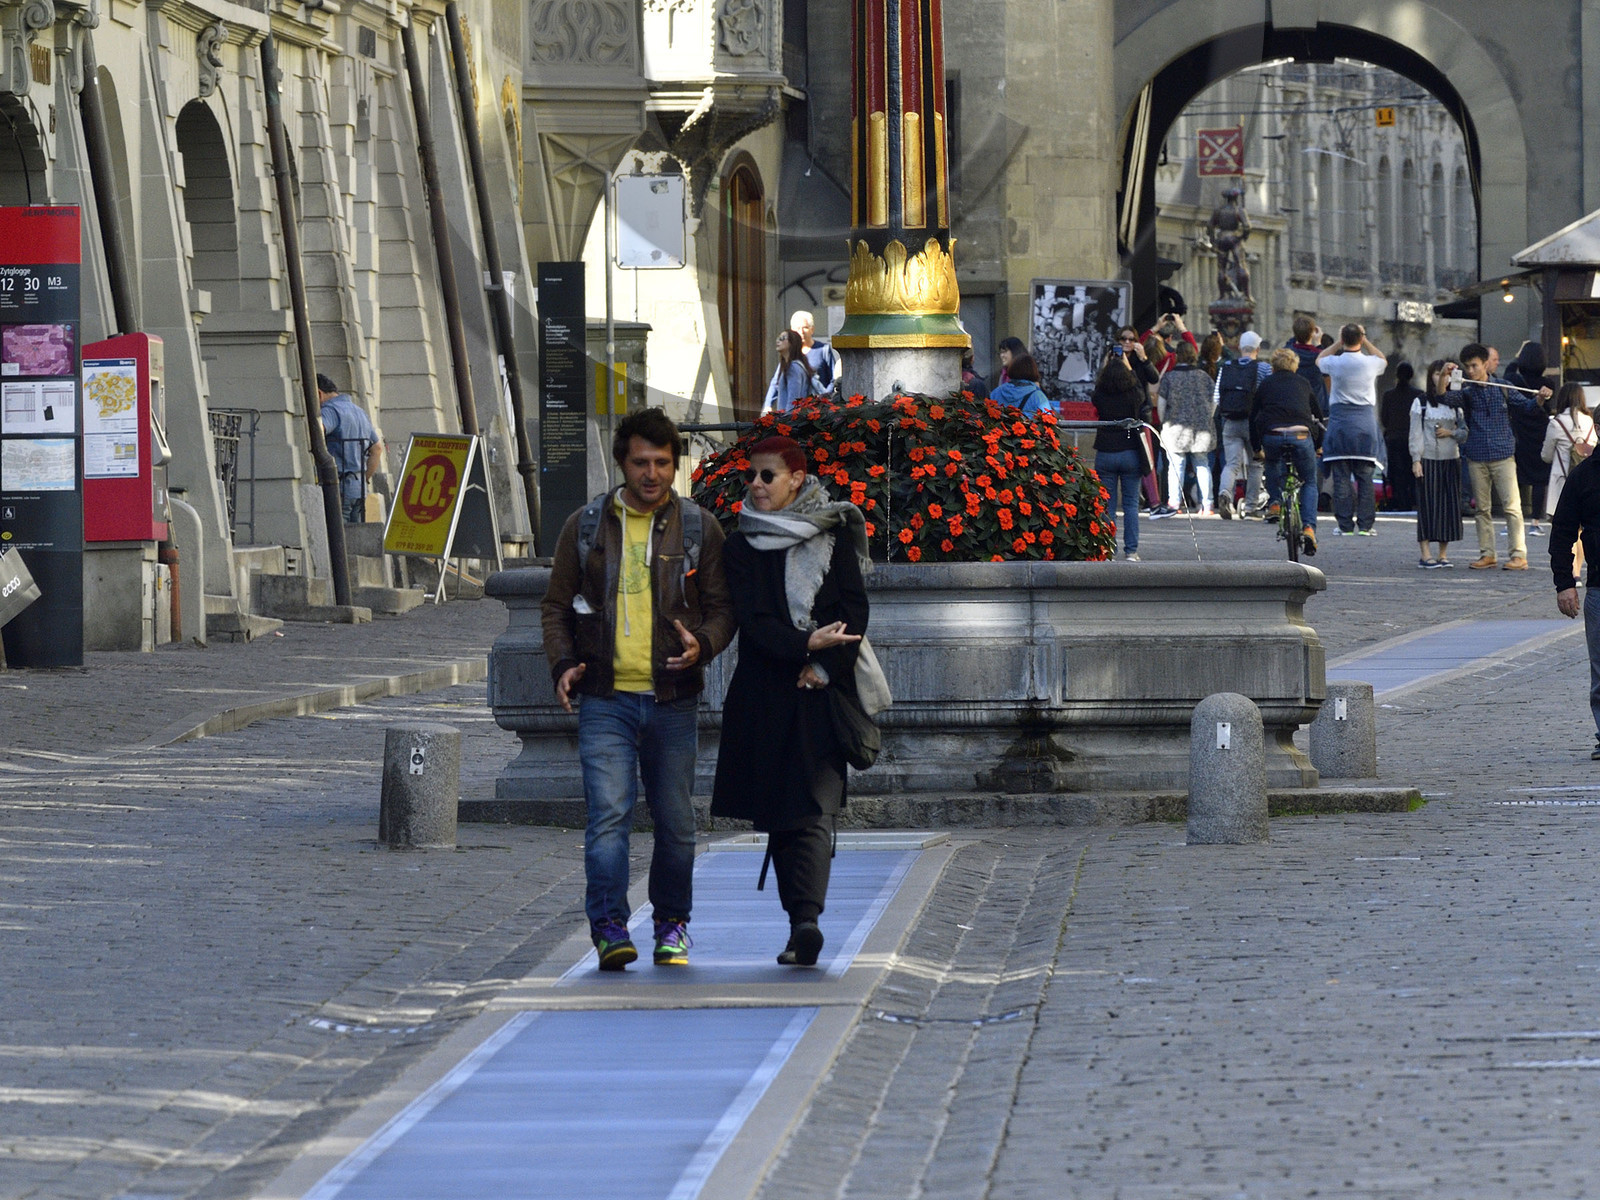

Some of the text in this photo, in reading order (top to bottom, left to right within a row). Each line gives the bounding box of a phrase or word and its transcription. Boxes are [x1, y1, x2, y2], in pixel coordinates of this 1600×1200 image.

[0, 267, 31, 277] Zytglogge
[1, 276, 62, 291] 12 30 M3
[1, 575, 21, 598] ecco
